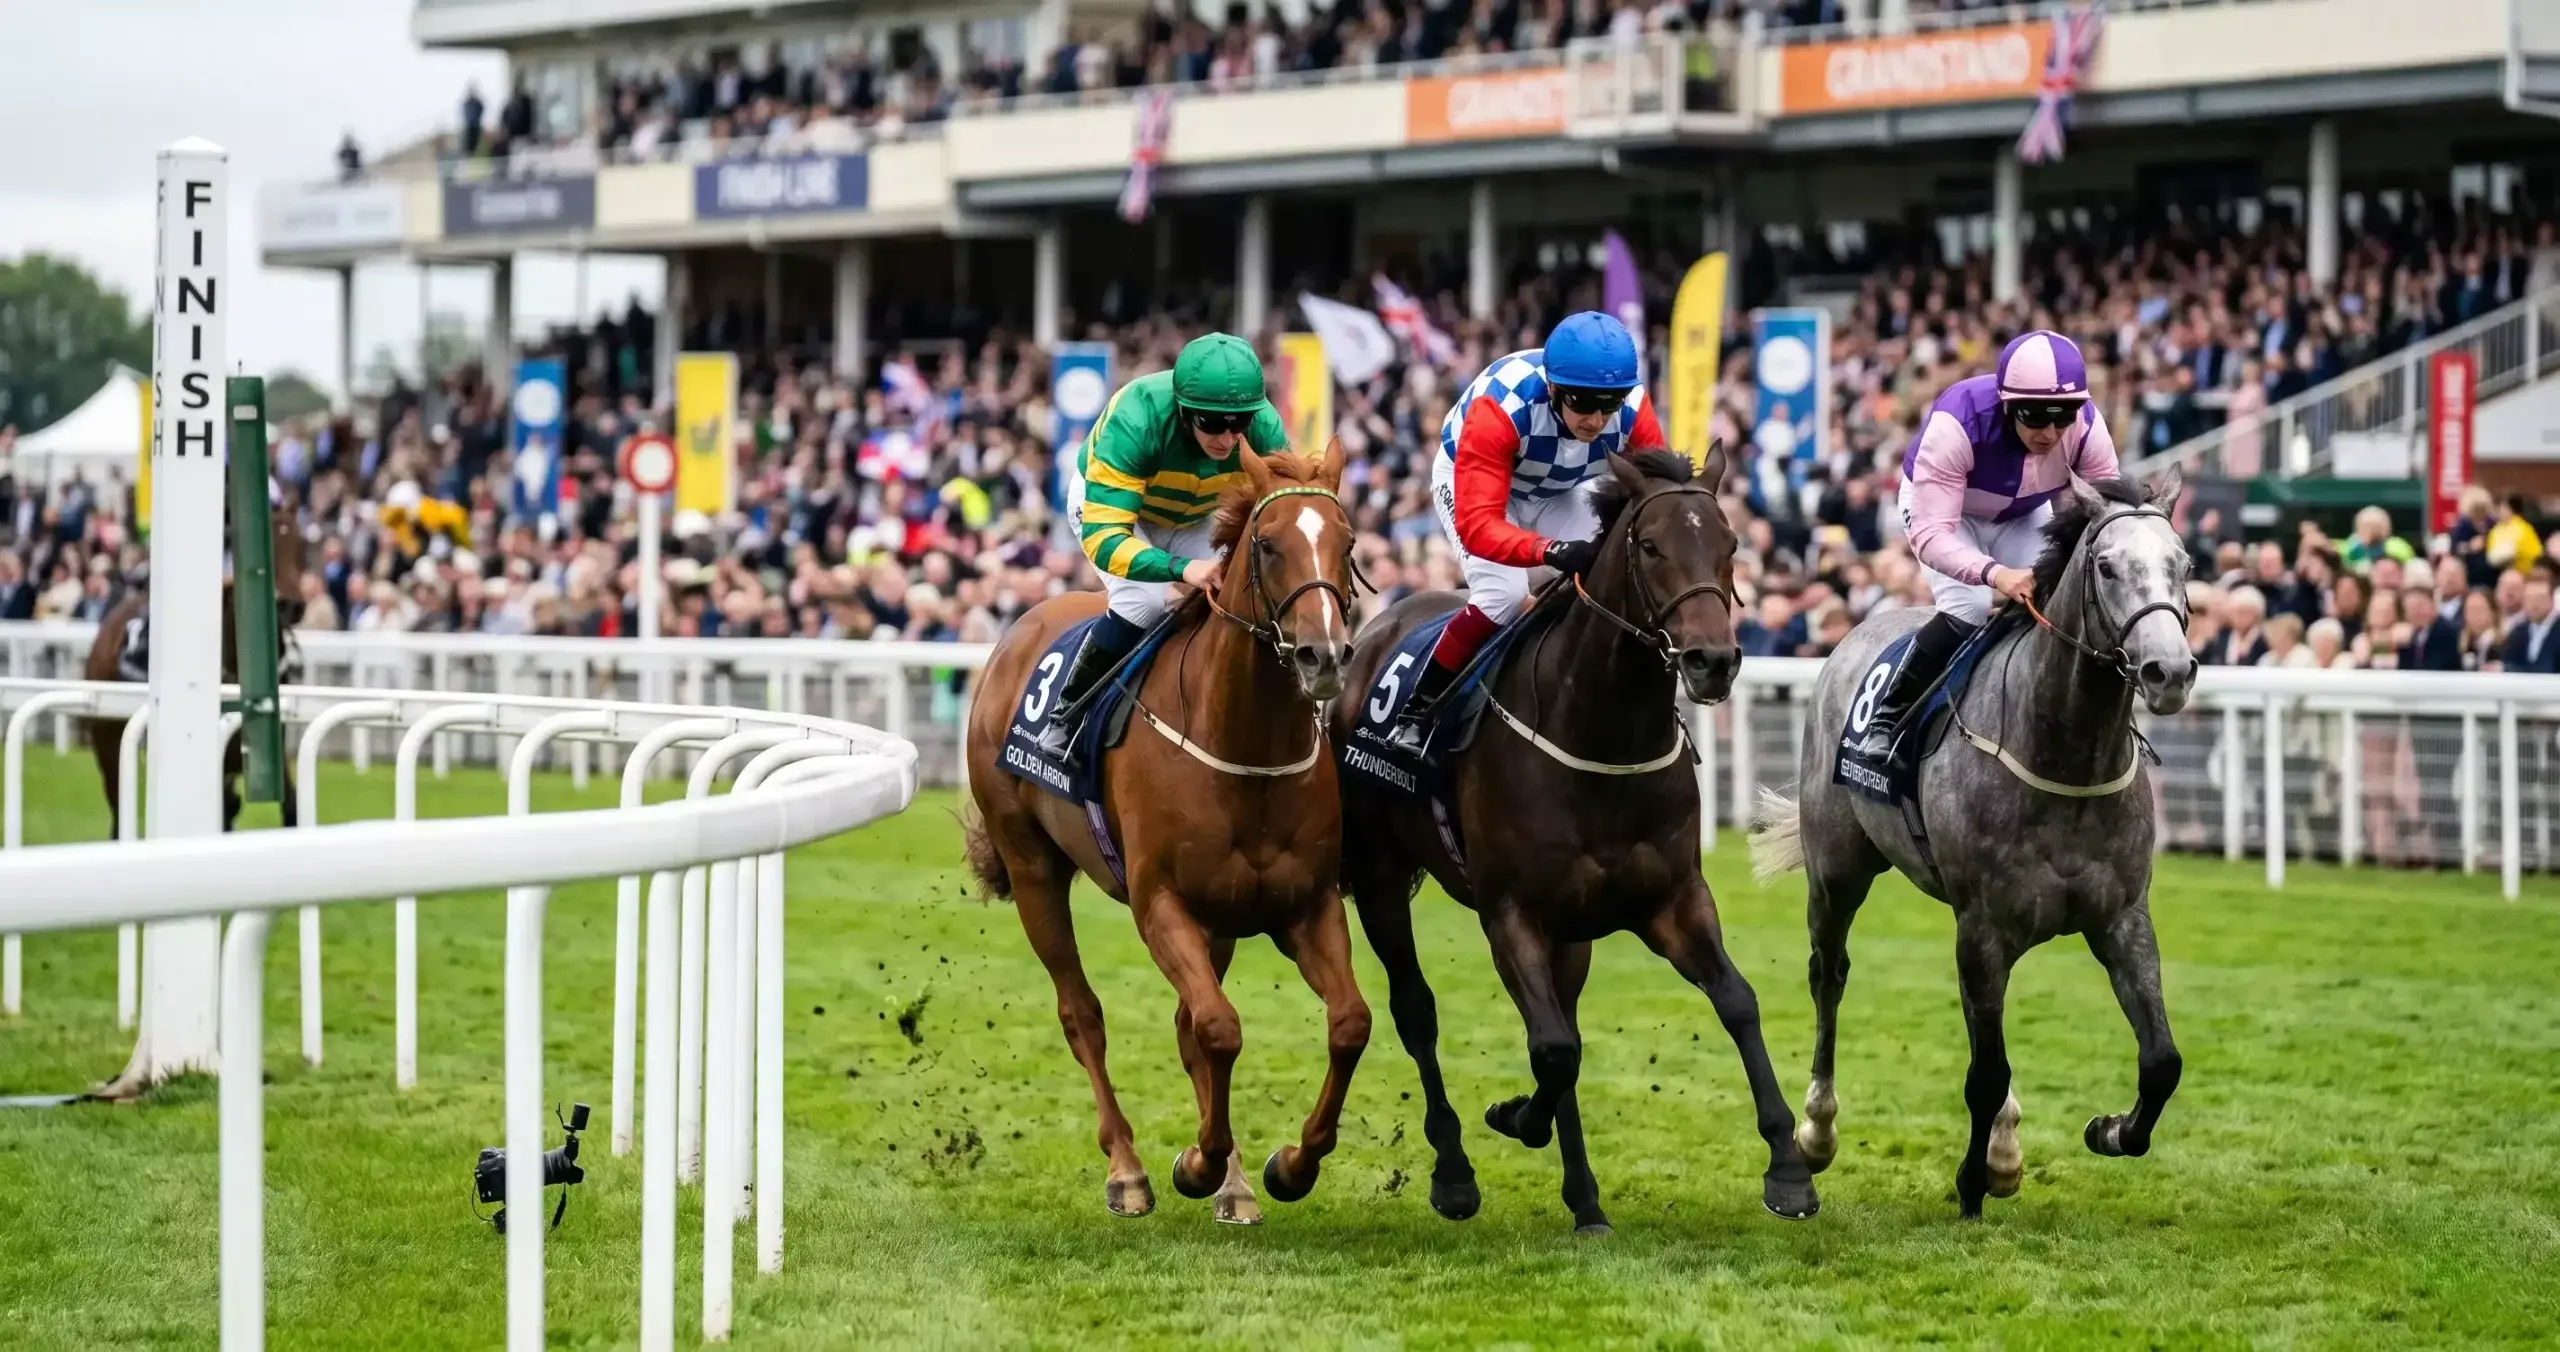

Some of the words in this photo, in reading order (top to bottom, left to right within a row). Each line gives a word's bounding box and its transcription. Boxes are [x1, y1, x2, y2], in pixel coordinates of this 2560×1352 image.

[176, 180, 216, 458] FINISH
[1024, 651, 1064, 723] 3
[1369, 651, 1416, 724] 5
[1852, 662, 1892, 734] 8
[1344, 744, 1417, 793] THUNDERBOLT
